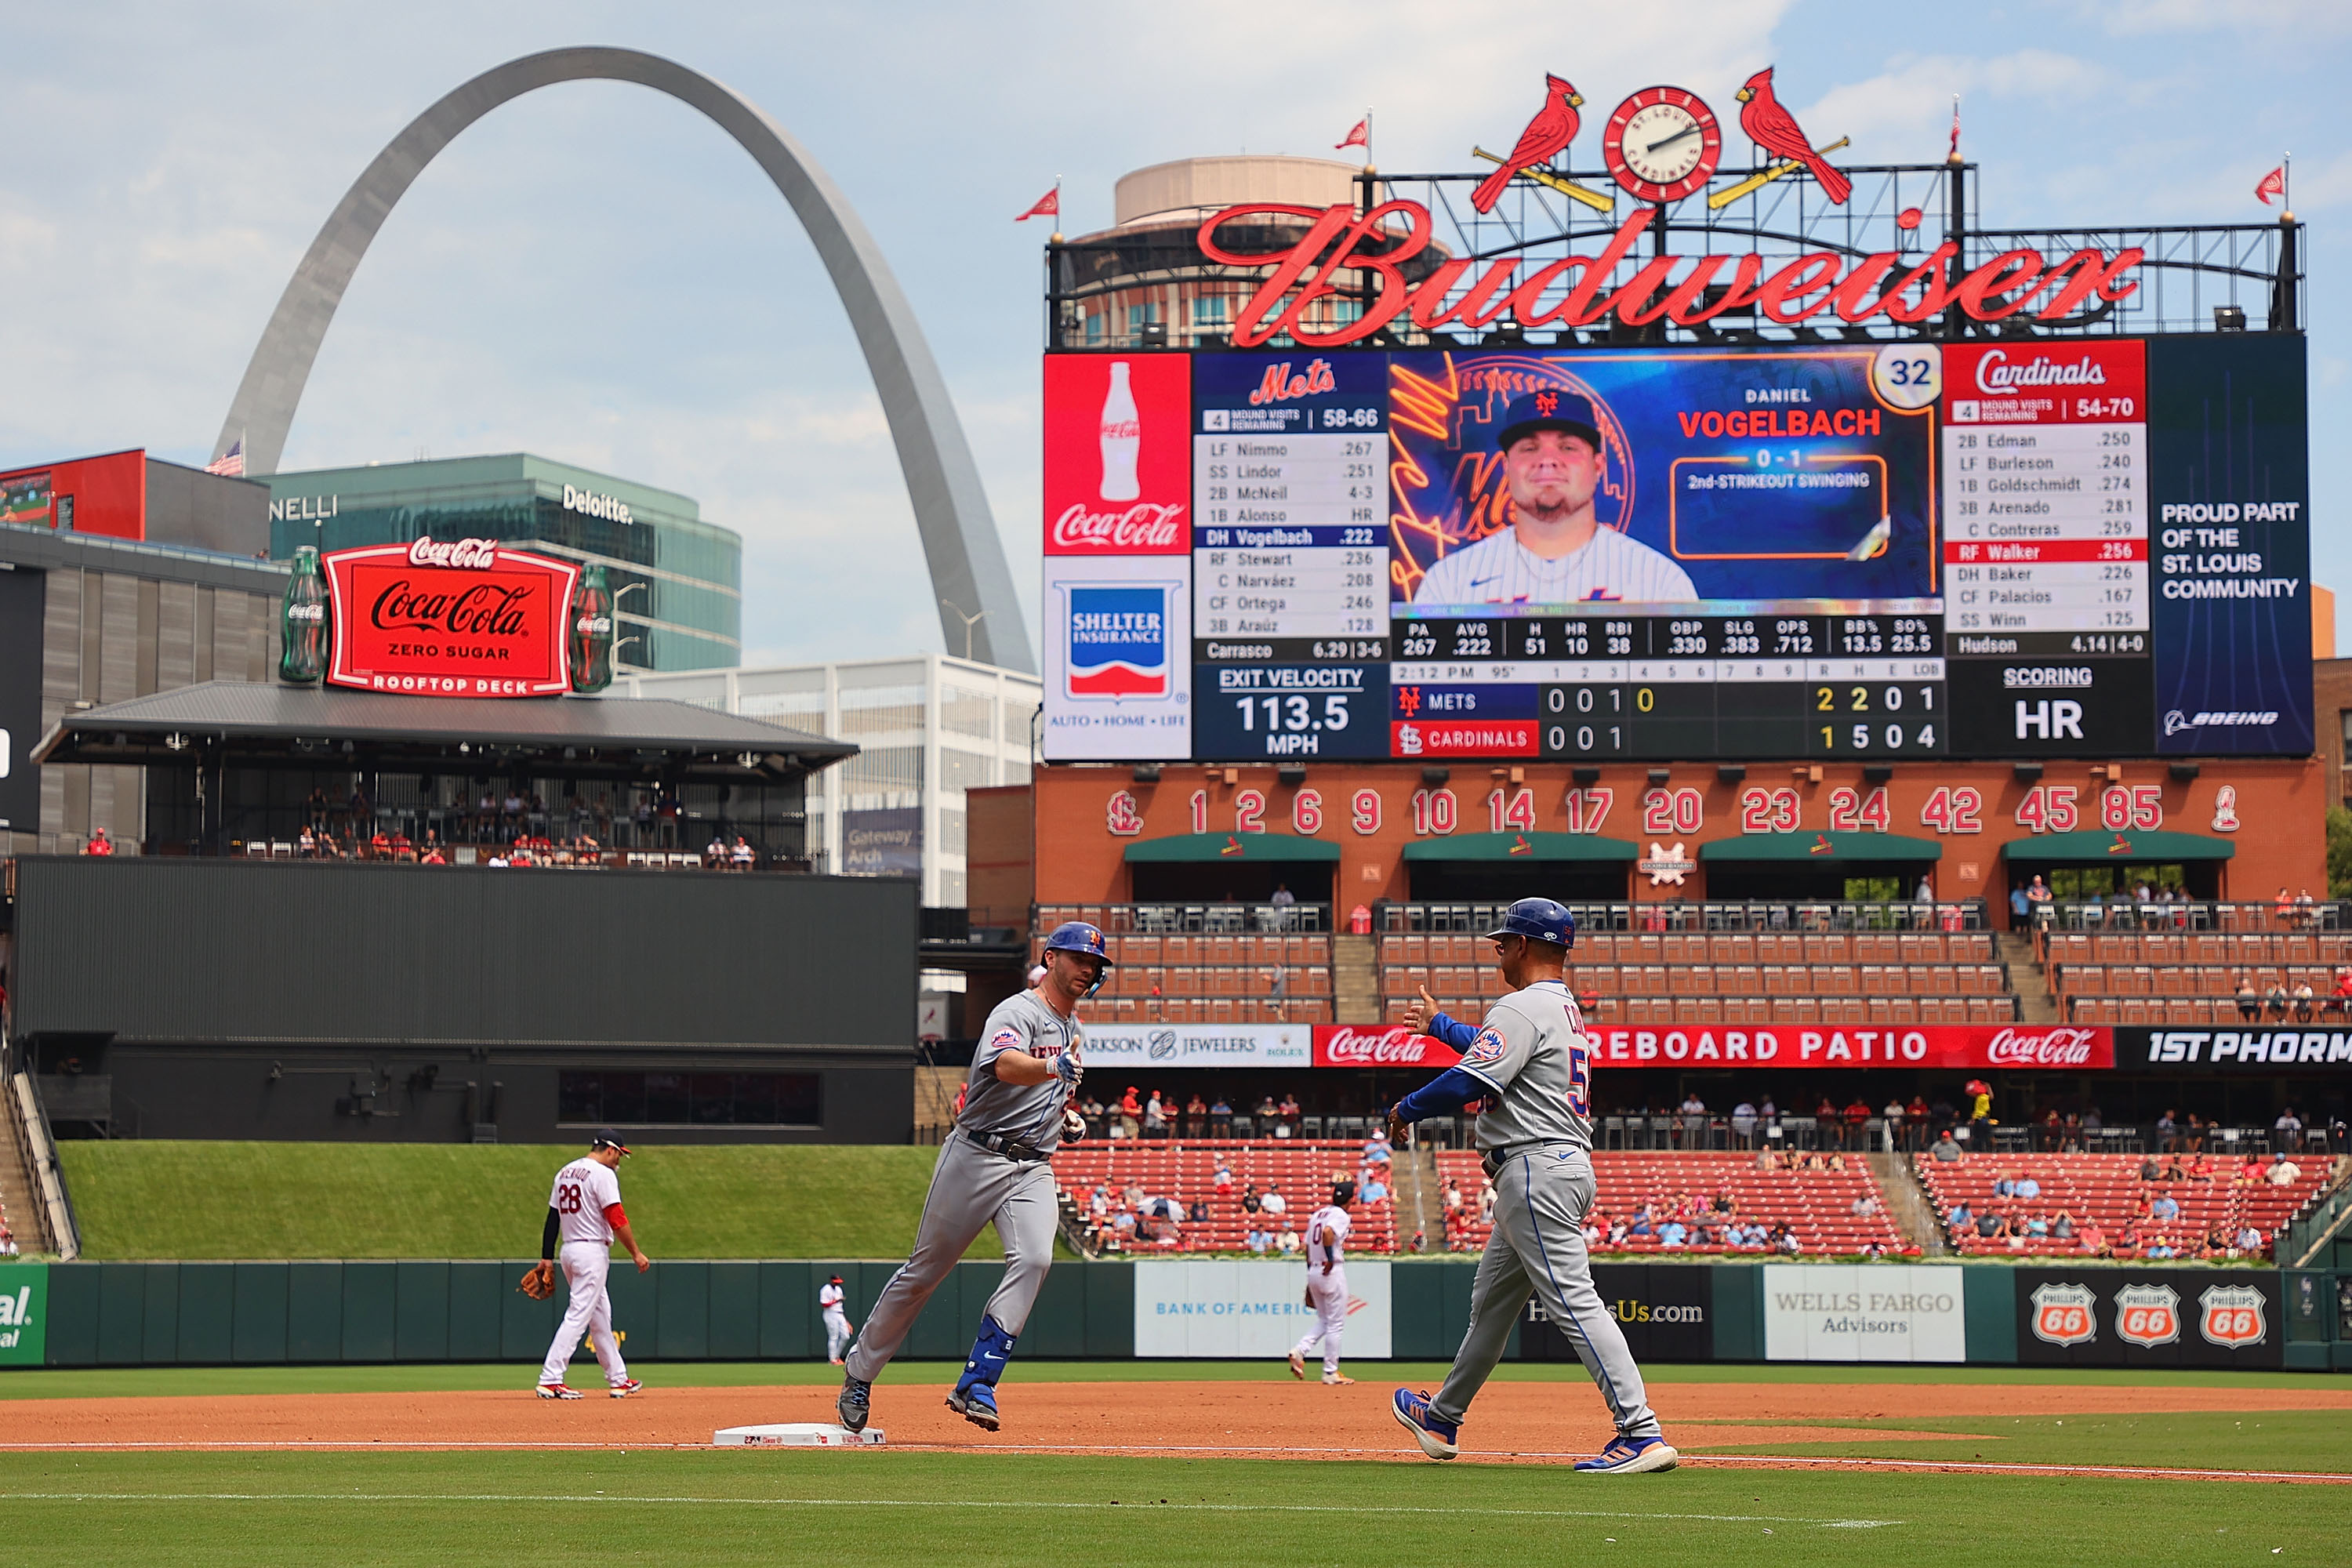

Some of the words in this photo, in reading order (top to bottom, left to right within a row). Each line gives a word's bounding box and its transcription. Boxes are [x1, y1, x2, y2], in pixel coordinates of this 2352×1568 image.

[1199, 199, 2145, 348] Budweiser
[1890, 360, 1931, 385] 32
[1975, 349, 2107, 395] Cardinals
[1249, 358, 1337, 405] Mets
[1745, 389, 1812, 404] DANIEL
[1981, 400, 2018, 410] MOUND
[2020, 400, 2053, 410] VISITS
[2077, 397, 2134, 417] 54-70
[1982, 411, 2038, 421] REMAINING
[1231, 409, 1267, 419] MOUND
[1268, 409, 1301, 419] VISITS
[1323, 408, 1378, 427] 58-66
[1232, 420, 1286, 430] REMAINING
[1678, 409, 1881, 438] VOGELBACH
[1988, 434, 2036, 447] Edman
[2097, 432, 2130, 446] .250
[1238, 443, 1288, 456] Nimmo
[1340, 443, 1372, 456] .267
[1238, 465, 1282, 477] Lindor
[1342, 465, 1374, 477] .251
[1988, 456, 2053, 470] Burleson
[2097, 455, 2130, 468] .240
[1799, 472, 1870, 488] SWINGING
[1988, 477, 2082, 492] Goldschmidt
[2097, 477, 2131, 491] .274
[1238, 486, 1287, 499] McNeil
[1349, 486, 1372, 499] 4-3
[270, 494, 337, 522] NELLI
[562, 483, 633, 525] Deloitte.
[1989, 500, 2049, 514] Arenado
[2101, 499, 2133, 514] .281
[2161, 503, 2240, 524] PROUD
[2244, 502, 2299, 521] PART
[1238, 508, 1287, 522] Alonso
[1351, 508, 1372, 521] HR
[1053, 503, 1186, 546] Coca-Cola
[1989, 522, 2060, 536] Contreras
[2099, 521, 2132, 535] .259
[1207, 528, 1229, 545] DH
[1236, 528, 1312, 548] Vogelbach
[1339, 528, 1373, 543] .222
[2161, 529, 2193, 548] OF
[2196, 528, 2240, 547] THE
[408, 535, 499, 569] Coca-Cola
[1238, 552, 1292, 565] Stewart
[1341, 552, 1373, 564] .236
[1959, 545, 1980, 560] RF
[1988, 545, 2040, 560] Walker
[2097, 544, 2133, 559] .256
[2162, 554, 2193, 573] ST.
[2197, 553, 2262, 572] LOUIS
[1341, 574, 1373, 586] .208
[1990, 567, 2031, 581] Baker
[2099, 566, 2132, 580] .226
[1990, 590, 2052, 604] Palacios
[2099, 590, 2132, 603] .167
[2162, 579, 2299, 599] COMMUNITY
[289, 603, 324, 620] Coca-Cola
[371, 579, 536, 637] Coca-Cola
[1238, 597, 1286, 612] Ortega
[1341, 596, 1373, 609] .246
[576, 616, 611, 633] Coca-Cola
[1072, 612, 1162, 630] SHELTER
[1341, 618, 1374, 631] .128
[1990, 613, 2026, 626] Winn
[2100, 612, 2133, 626] .125
[1073, 630, 1161, 644] INSURANCE
[1403, 638, 1437, 655] 267
[1453, 637, 1491, 655] .222
[1525, 638, 1546, 655] 51
[1566, 638, 1588, 655] 10
[1607, 637, 1631, 655] 38
[1668, 637, 1707, 653] .330
[1720, 636, 1760, 653] .383
[1773, 636, 1813, 653] .712
[1843, 635, 1882, 652] 13.5
[1891, 635, 1932, 652] 25.5
[1959, 637, 2017, 652] Hudson
[388, 643, 438, 658] ZERO
[446, 644, 510, 660] SUGAR
[1207, 643, 1272, 658] Carrasco
[1219, 670, 1263, 687] EXIT
[1269, 670, 1363, 687] VELOCITY
[1399, 666, 1438, 678] 2:12
[1914, 664, 1940, 677] LOB
[2003, 668, 2093, 686] SCORING
[374, 675, 466, 692] ROOFTOP
[476, 679, 528, 695] DECK
[1428, 694, 1476, 710] METS
[1817, 687, 1834, 711] 2
[1851, 686, 1869, 711] 2
[1885, 686, 1902, 711] 0
[1920, 686, 1933, 710] 1
[1050, 715, 1091, 727] AUTO
[1104, 715, 1145, 727] HOME
[1161, 715, 1185, 727] LIFE
[1236, 695, 1349, 731] 113.5
[2015, 700, 2084, 739] HR
[2191, 711, 2278, 726] BOEING
[1267, 735, 1319, 754] MPH
[1428, 730, 1527, 748] CARDINALS
[1820, 725, 1833, 750] 1
[1853, 724, 1870, 749] 5
[1885, 724, 1903, 749] 0
[1917, 724, 1936, 749] 4
[1190, 789, 1209, 835] 1
[1236, 789, 1266, 835] 2
[1293, 789, 1323, 834] 6
[1352, 789, 1382, 834] 9
[1413, 789, 1457, 835] 10
[1488, 789, 1536, 834] 14
[1566, 788, 1613, 834] 17
[1643, 788, 1703, 834] 20
[1741, 788, 1801, 833] 23
[1829, 787, 1889, 833] 24
[1920, 786, 1982, 833] 42
[2015, 786, 2078, 833] 45
[2101, 786, 2163, 832] 85
[848, 829, 913, 848] Gateway
[848, 848, 883, 866] Arch
[1182, 1036, 1257, 1055] JEWELERS
[1327, 1027, 1427, 1062] Coca-Cola
[1801, 1031, 1929, 1061] PATIO
[1987, 1027, 2096, 1065] Coca-Cola
[2148, 1032, 2211, 1063] 1ST
[558, 1184, 581, 1214] 28
[1775, 1292, 1860, 1312] WELLS
[1869, 1292, 1955, 1312] FARGO
[2043, 1293, 2086, 1303] PHILLIPS
[2126, 1294, 2170, 1304] PHILLIPS
[2211, 1294, 2255, 1305] PHILLIPS
[1156, 1301, 1207, 1316] BANK
[1212, 1301, 1237, 1316] OF
[1241, 1302, 1319, 1316] AMERIC
[1822, 1317, 1908, 1334] Advisors
[2044, 1308, 2083, 1332] 66
[2127, 1309, 2167, 1333] 66
[2213, 1310, 2253, 1334] 66
